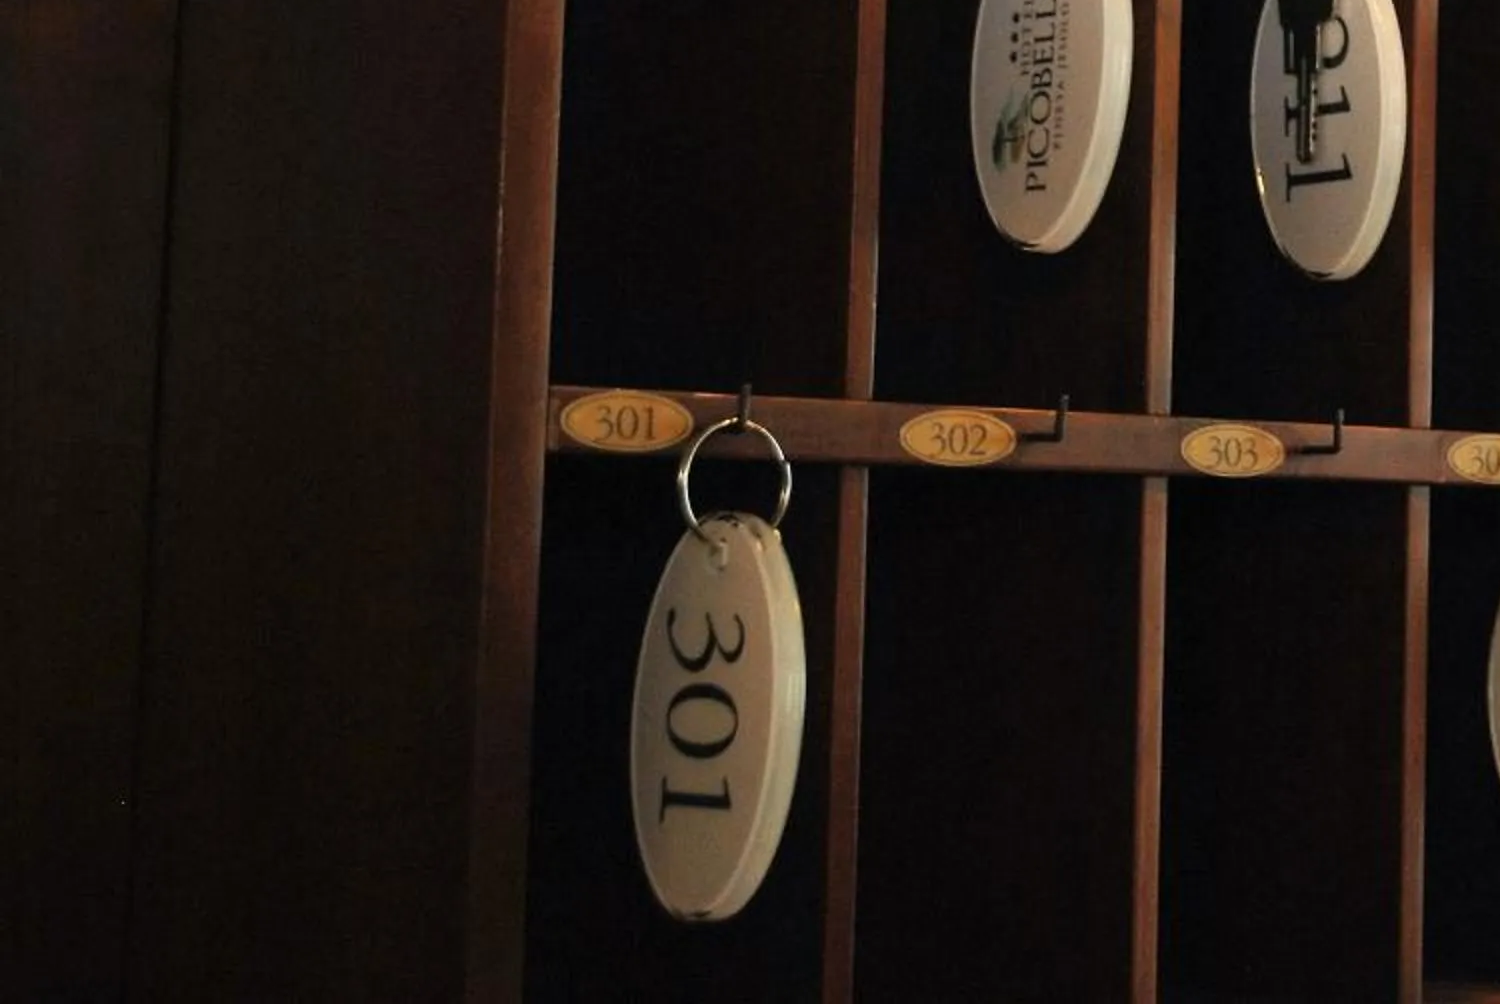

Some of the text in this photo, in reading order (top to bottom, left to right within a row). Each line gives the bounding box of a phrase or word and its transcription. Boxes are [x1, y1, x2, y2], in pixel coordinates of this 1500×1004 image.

[592, 406, 657, 441] 301
[929, 424, 988, 456] 302
[1206, 437, 1259, 469] 303
[658, 607, 746, 826] 301
